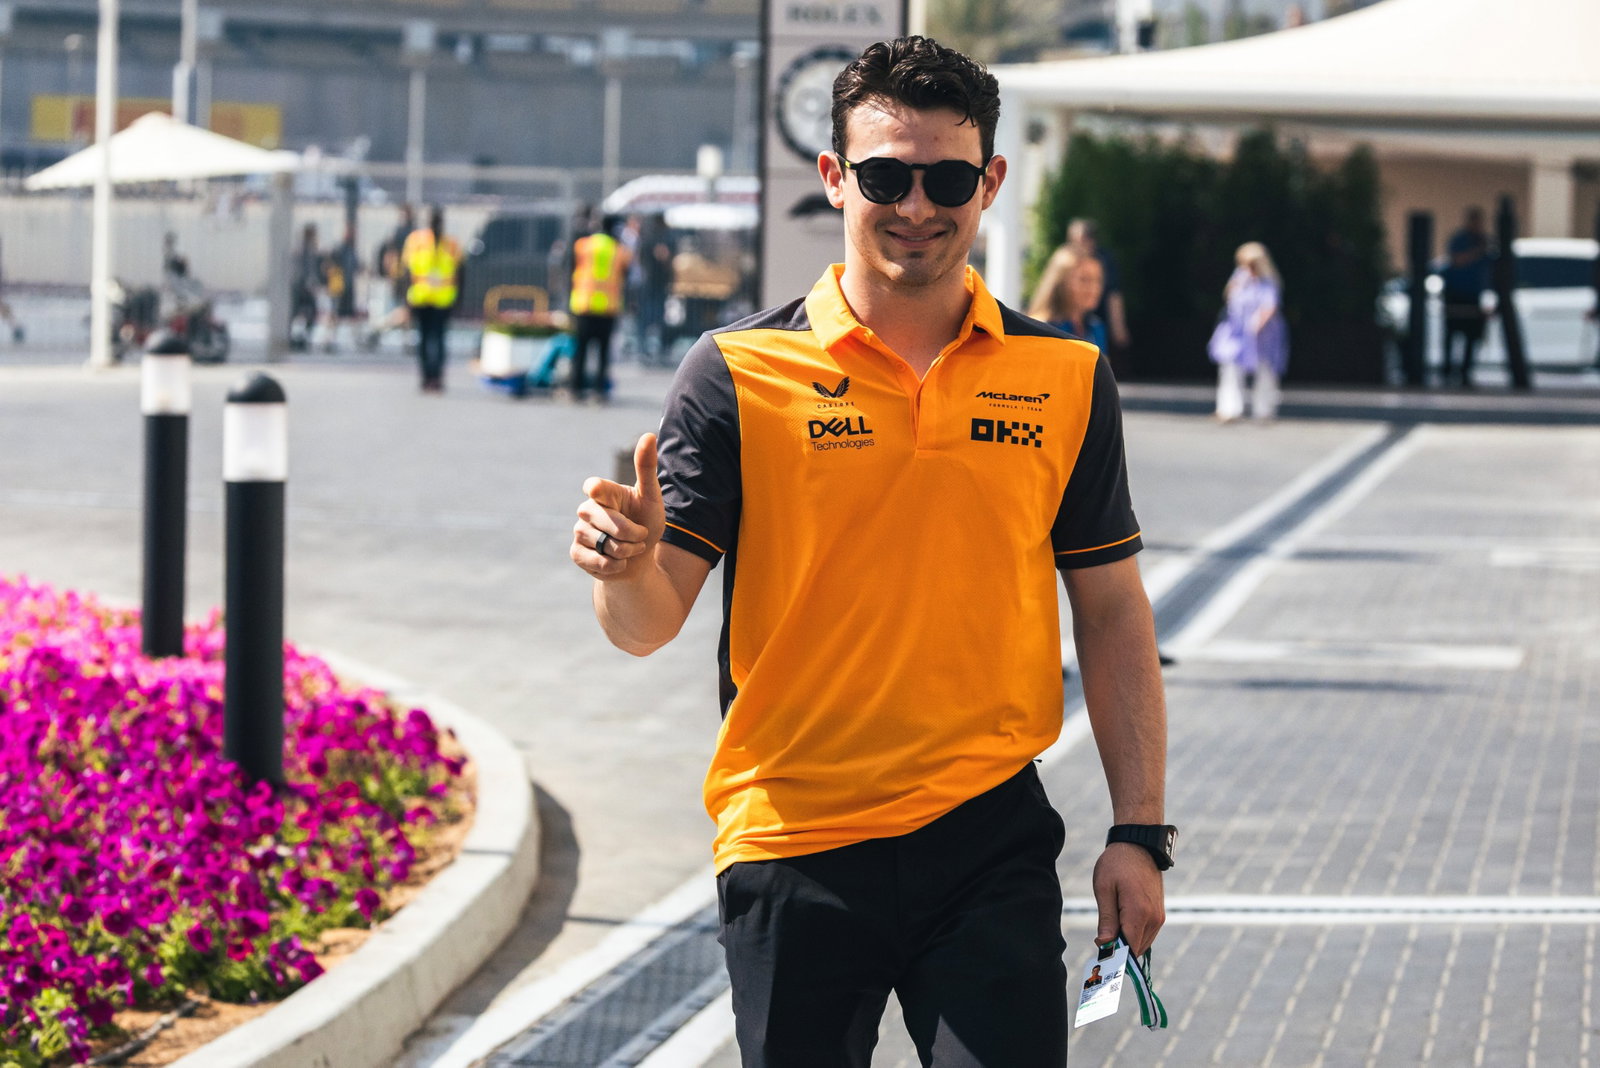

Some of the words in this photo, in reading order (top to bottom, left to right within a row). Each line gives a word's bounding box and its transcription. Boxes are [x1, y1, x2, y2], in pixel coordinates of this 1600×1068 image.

[976, 391, 1049, 404] McLaren
[817, 401, 855, 409] CASTORE
[808, 416, 873, 439] DELL
[971, 418, 1043, 448] OKX
[811, 438, 875, 451] Technologies
